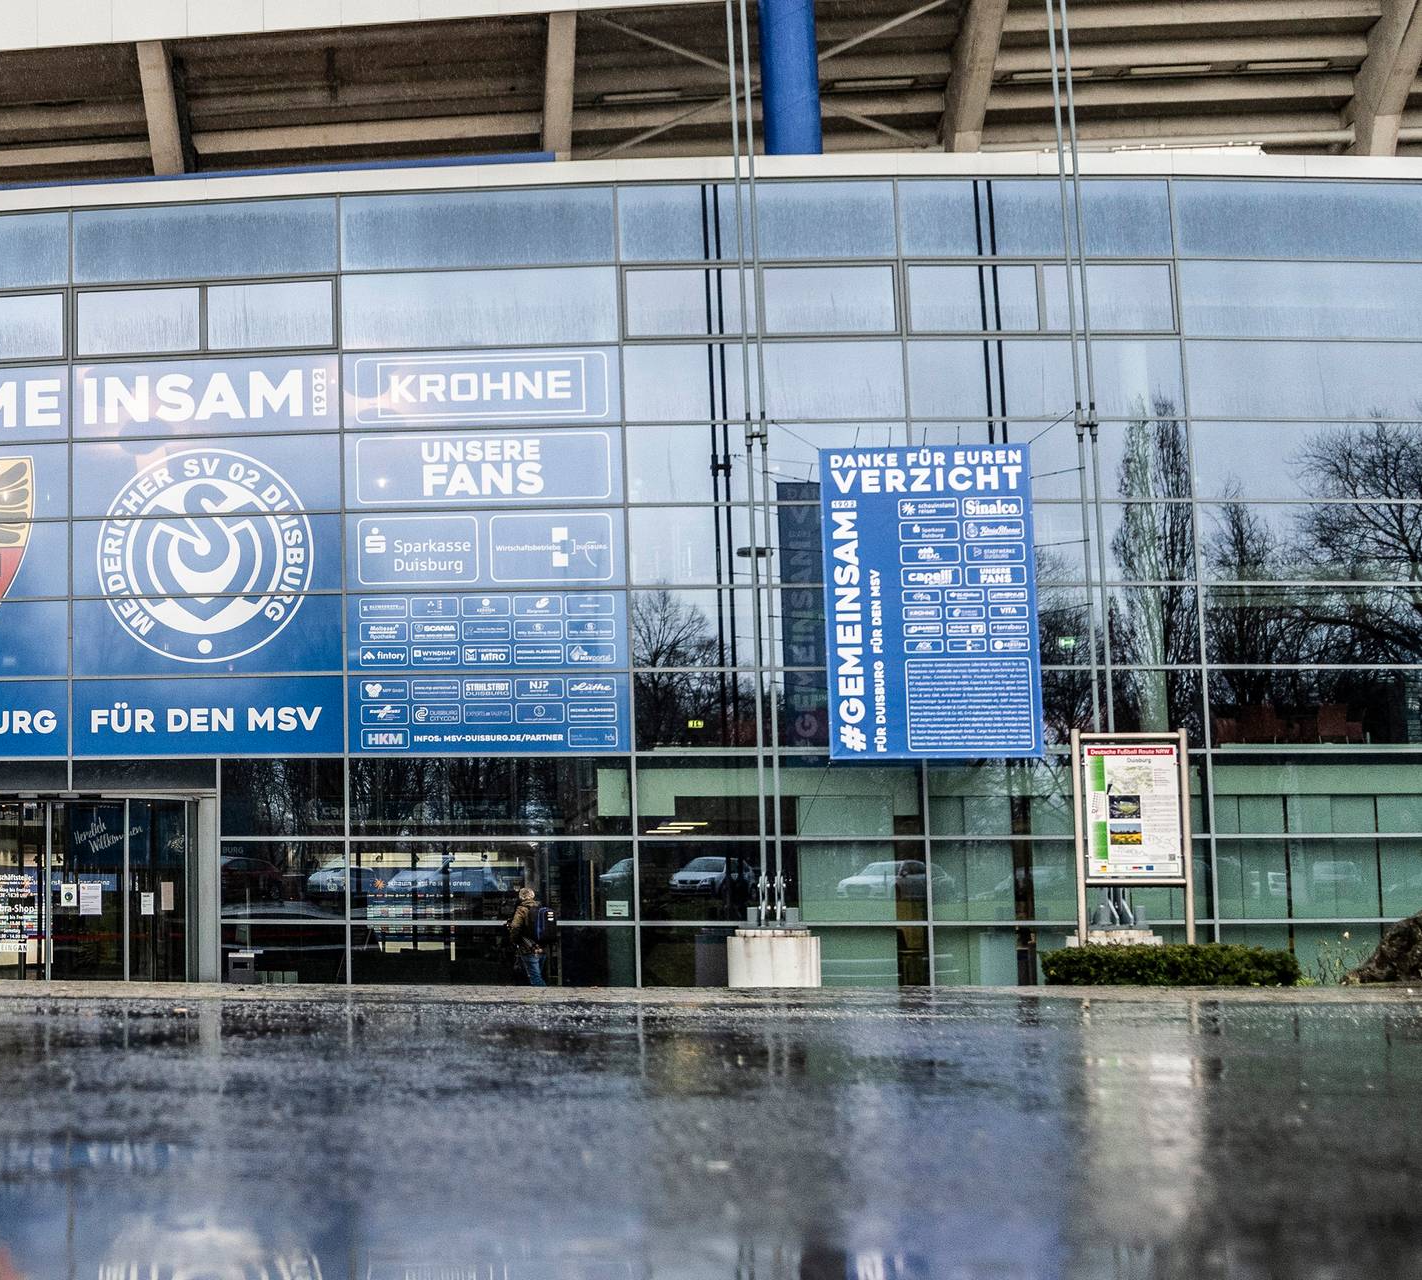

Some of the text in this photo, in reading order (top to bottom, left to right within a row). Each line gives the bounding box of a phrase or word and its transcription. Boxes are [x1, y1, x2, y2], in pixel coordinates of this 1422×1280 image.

[313, 369, 326, 415] 1902
[390, 370, 572, 403] KROHNE
[421, 439, 540, 463] UNSERE
[830, 449, 1022, 469] DANKE FÜR EUREN
[422, 461, 545, 496] FANS
[831, 466, 1022, 494] VERZICHT
[183, 457, 220, 478] SV
[228, 462, 261, 490] 02
[260, 483, 305, 622] DUISBURG
[393, 539, 471, 554] Sparkasse
[496, 544, 562, 552] Wirtschaftsbetriebe
[394, 557, 464, 573] Duisburg
[908, 569, 952, 582] capelli
[980, 574, 1012, 583] FANS
[832, 512, 866, 752] #GEMEINSAM
[378, 651, 405, 661] fintory
[869, 569, 887, 752] FÜR DUISBURG FÜR DEN MSV
[90, 702, 323, 734] FÜR DEN MSV
[368, 733, 403, 745] HKM
[444, 733, 563, 742] MSV-DUISBURG.DE/PARTNER
[74, 817, 107, 845] Herzlich
